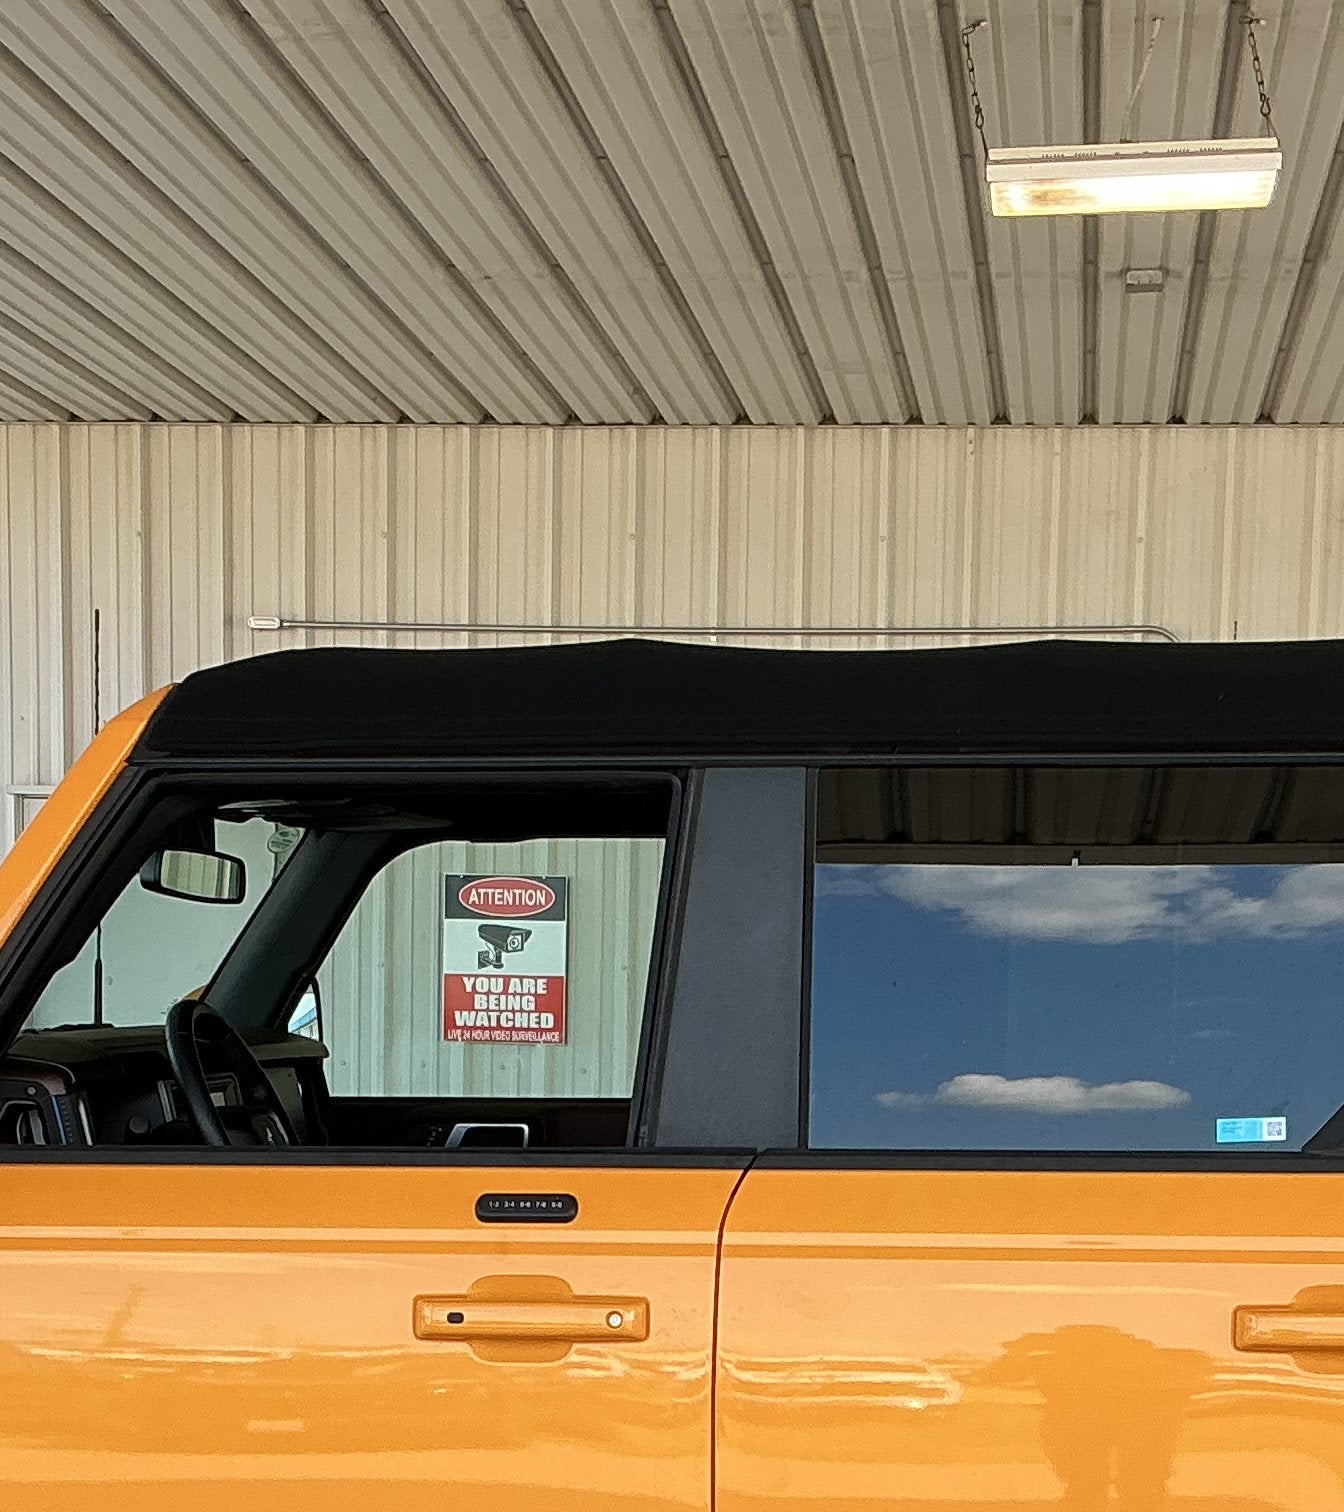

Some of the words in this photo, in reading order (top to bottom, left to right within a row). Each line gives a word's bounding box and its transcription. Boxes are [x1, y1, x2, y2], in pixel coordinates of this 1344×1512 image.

[468, 888, 546, 907] ATTENTION
[462, 976, 504, 994] YOU
[507, 978, 548, 995] ARE
[473, 994, 536, 1011] BEING
[454, 1010, 555, 1029] WATCHED
[447, 1029, 462, 1040] LIVE
[463, 1029, 471, 1040] 24
[471, 1030, 490, 1041] HOUR
[491, 1030, 511, 1041] VIDEO
[511, 1031, 560, 1042] SURVEILLANCE
